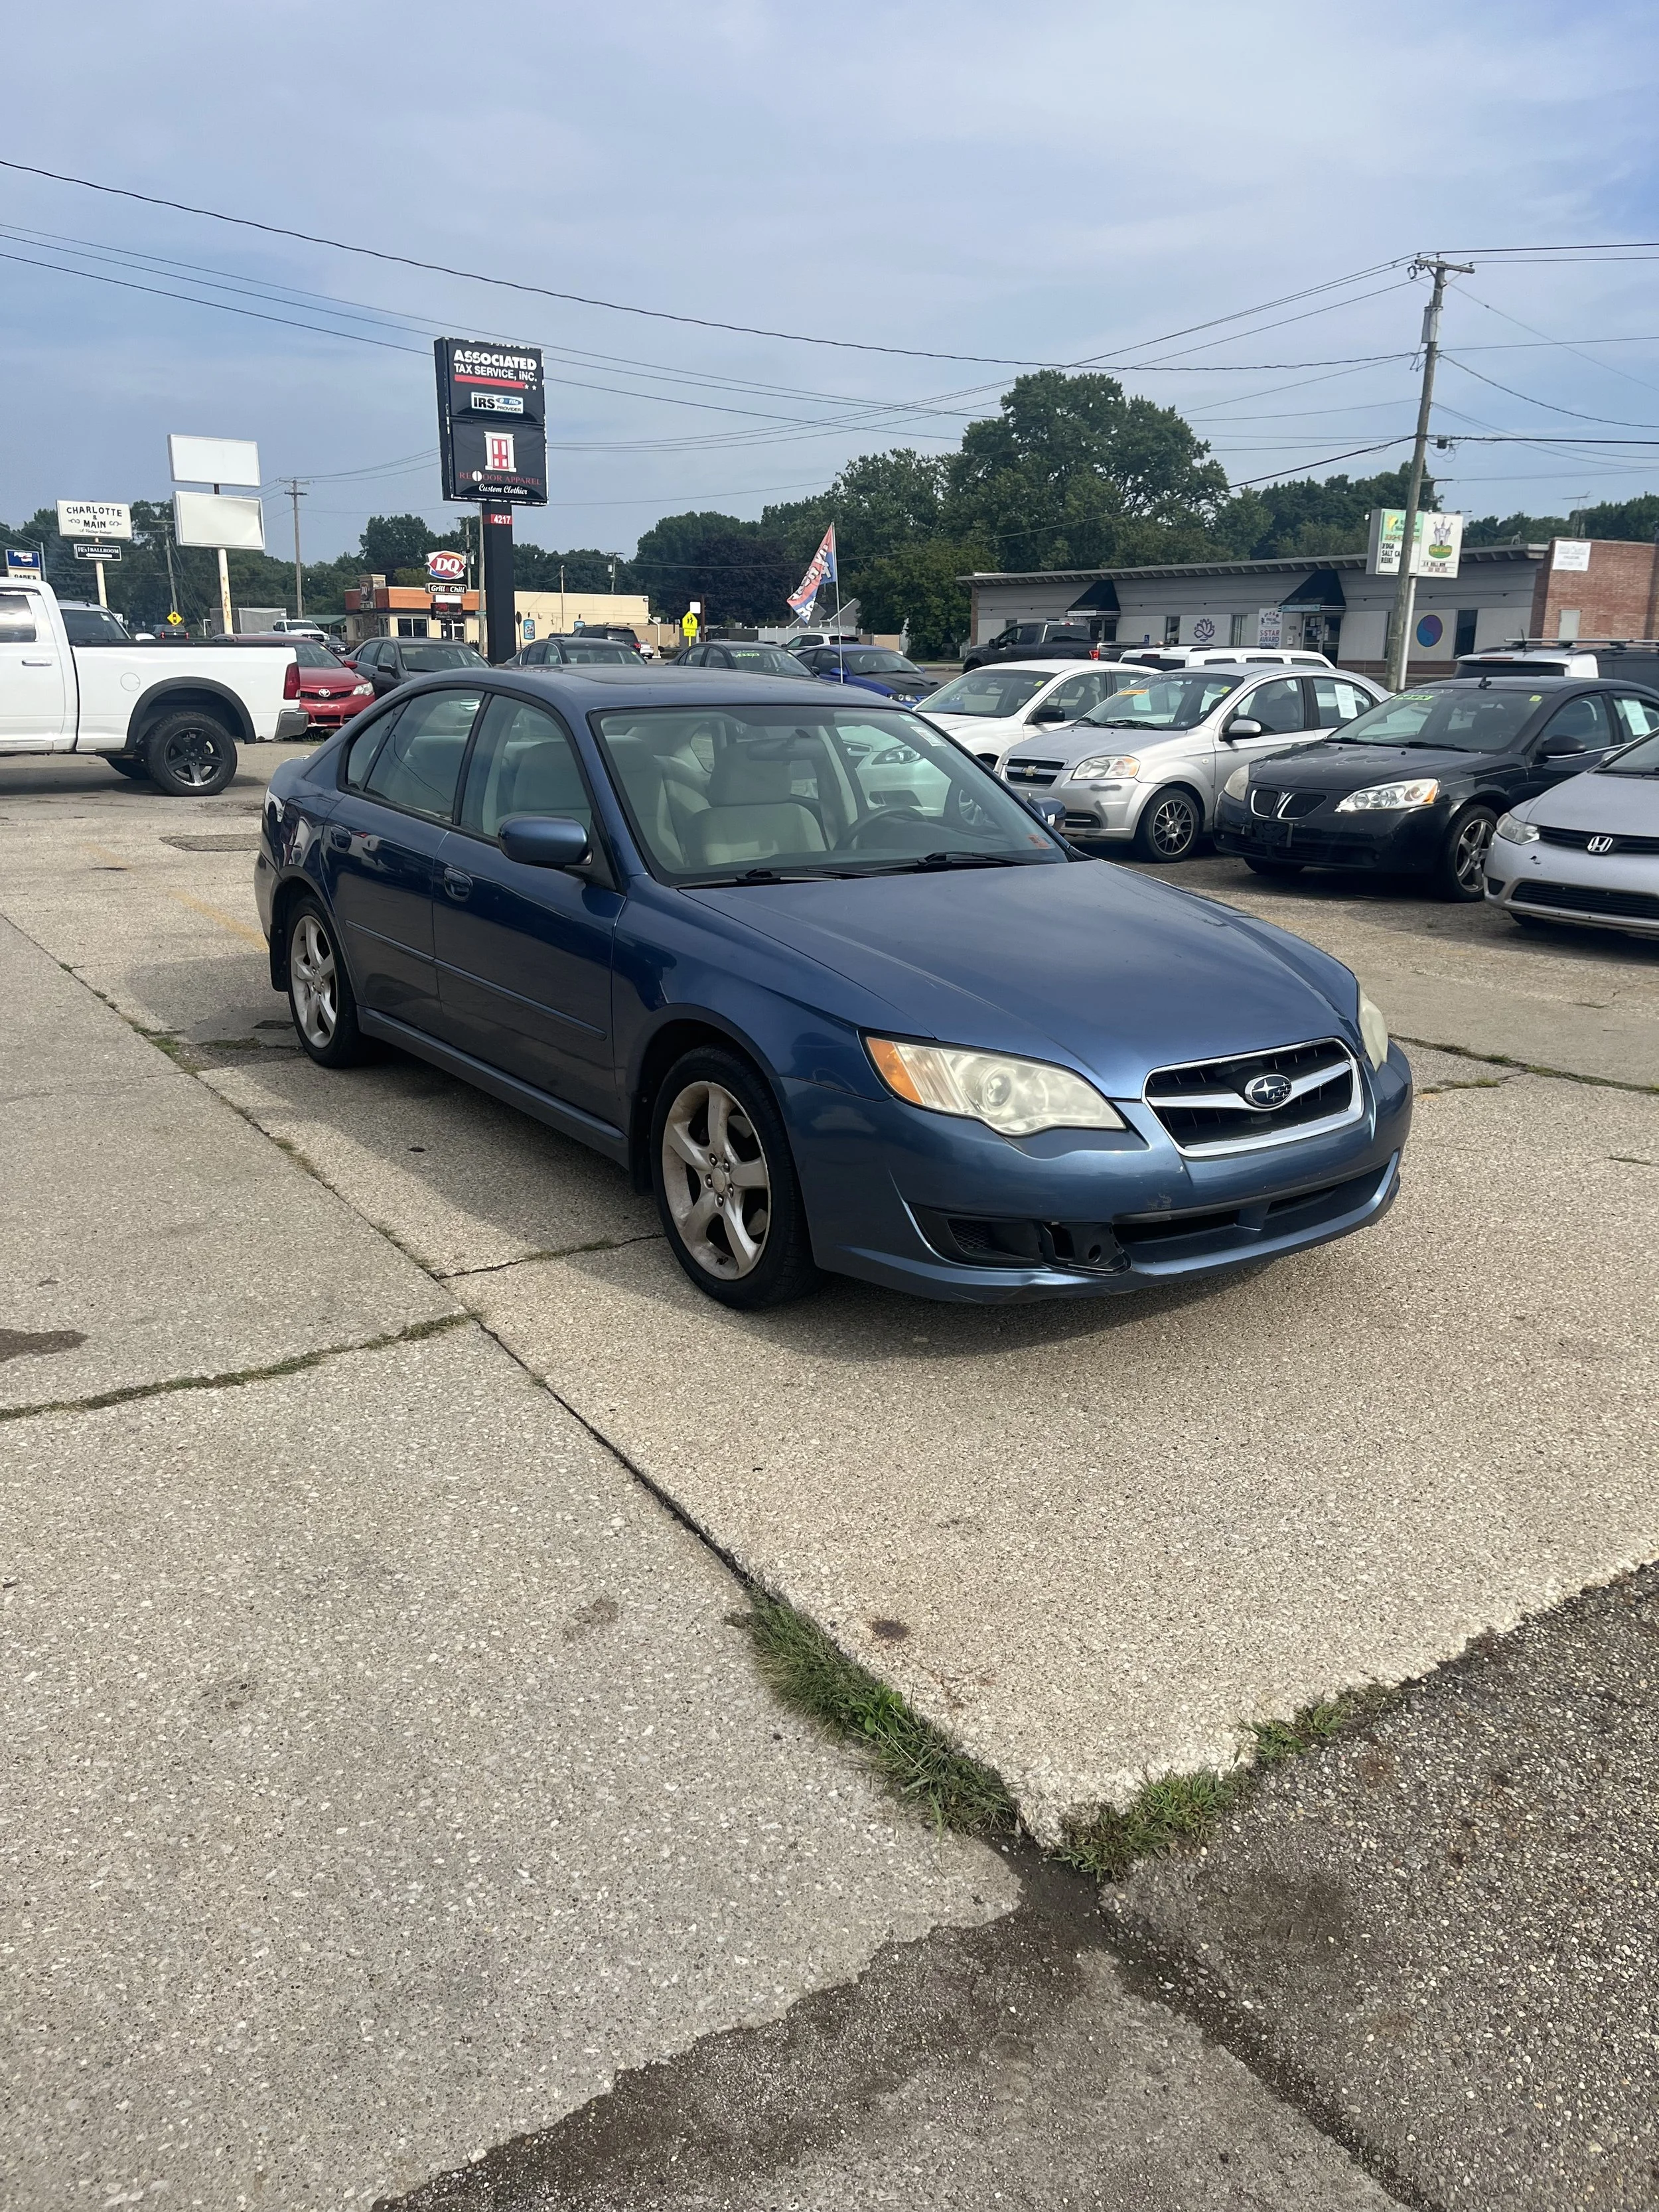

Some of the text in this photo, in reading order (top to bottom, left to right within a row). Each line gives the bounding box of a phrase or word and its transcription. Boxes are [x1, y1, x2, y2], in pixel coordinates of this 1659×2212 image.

[453, 349, 537, 370] ASSOCIATED
[454, 363, 538, 382] TAX SERVICE, INC.
[474, 397, 495, 409] IRS
[505, 477, 541, 485] APPAREL
[478, 483, 528, 495] Custom Clothier
[66, 506, 122, 517] CHARLOTTE
[84, 520, 106, 528] MAIN
[494, 515, 511, 524] 4217
[435, 557, 460, 573] DQ
